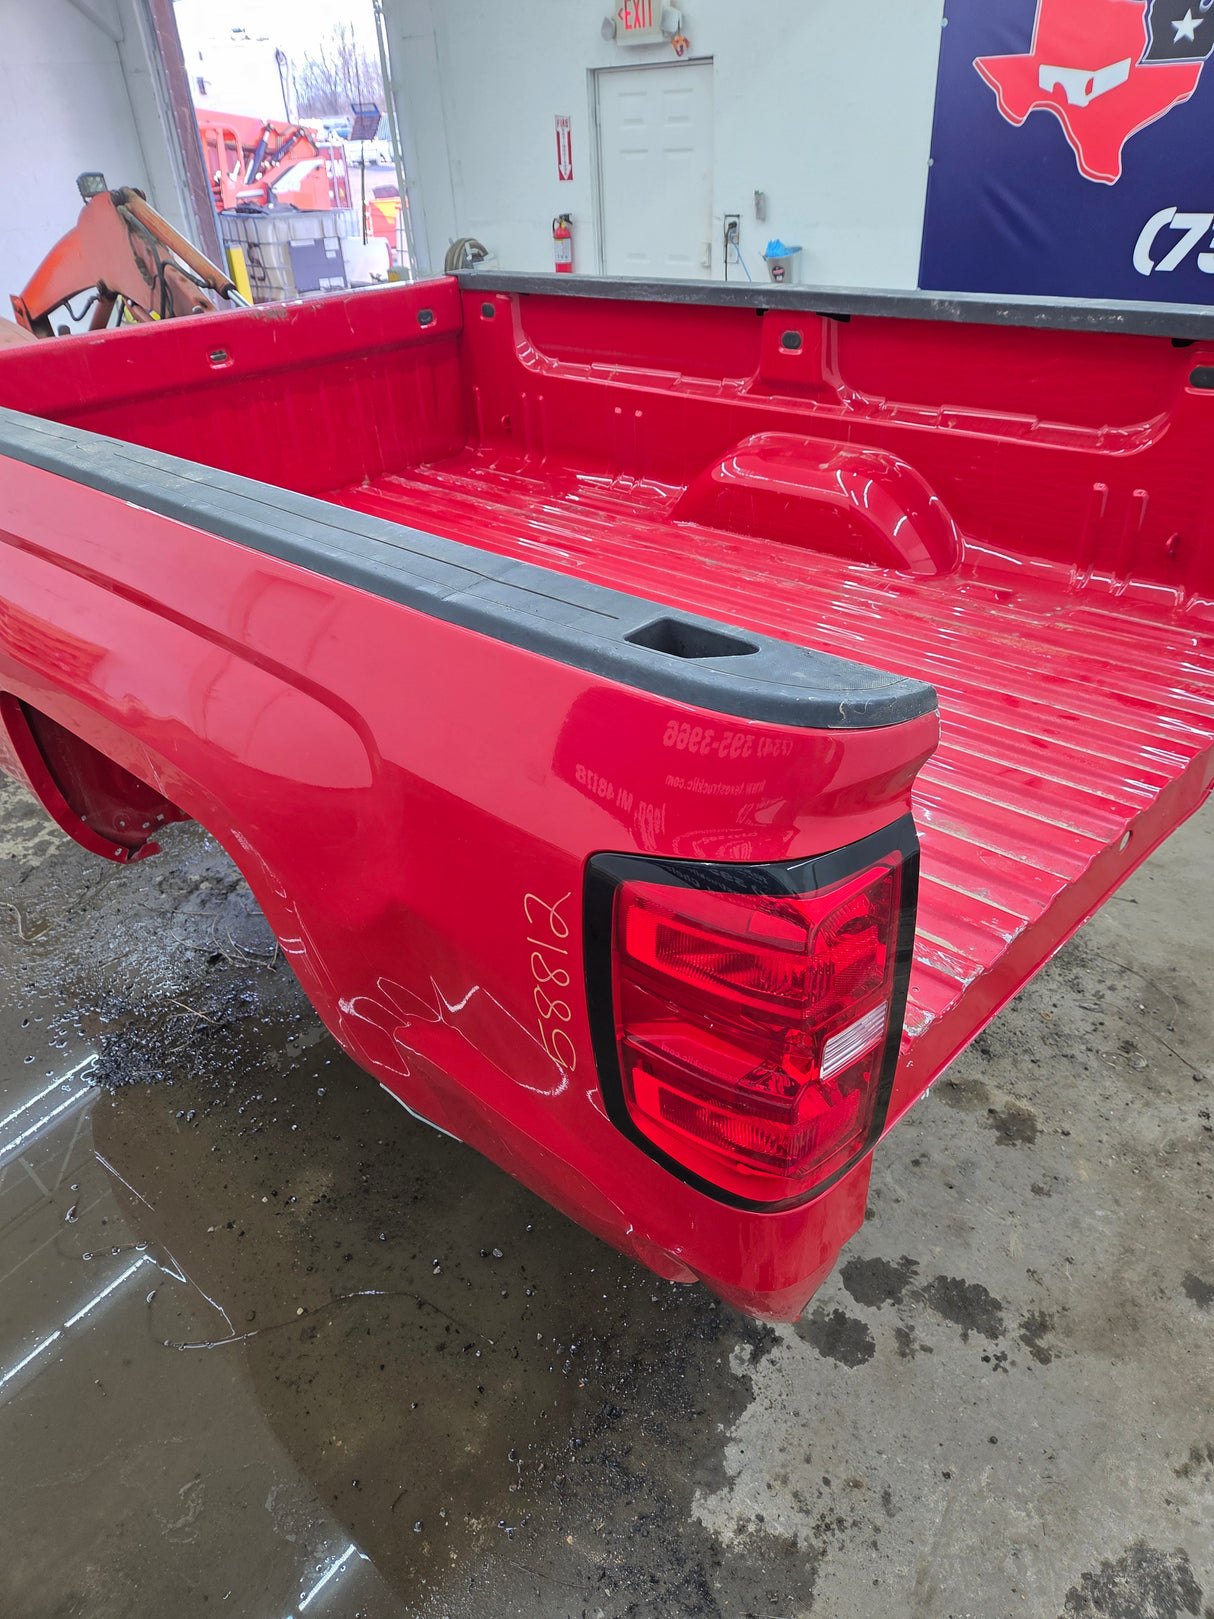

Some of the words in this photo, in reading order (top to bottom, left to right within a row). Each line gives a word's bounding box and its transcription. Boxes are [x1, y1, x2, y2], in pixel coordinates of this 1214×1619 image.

[624, 0, 652, 30] EXIT
[556, 119, 569, 128] FIRE
[524, 892, 576, 1072] 58812
